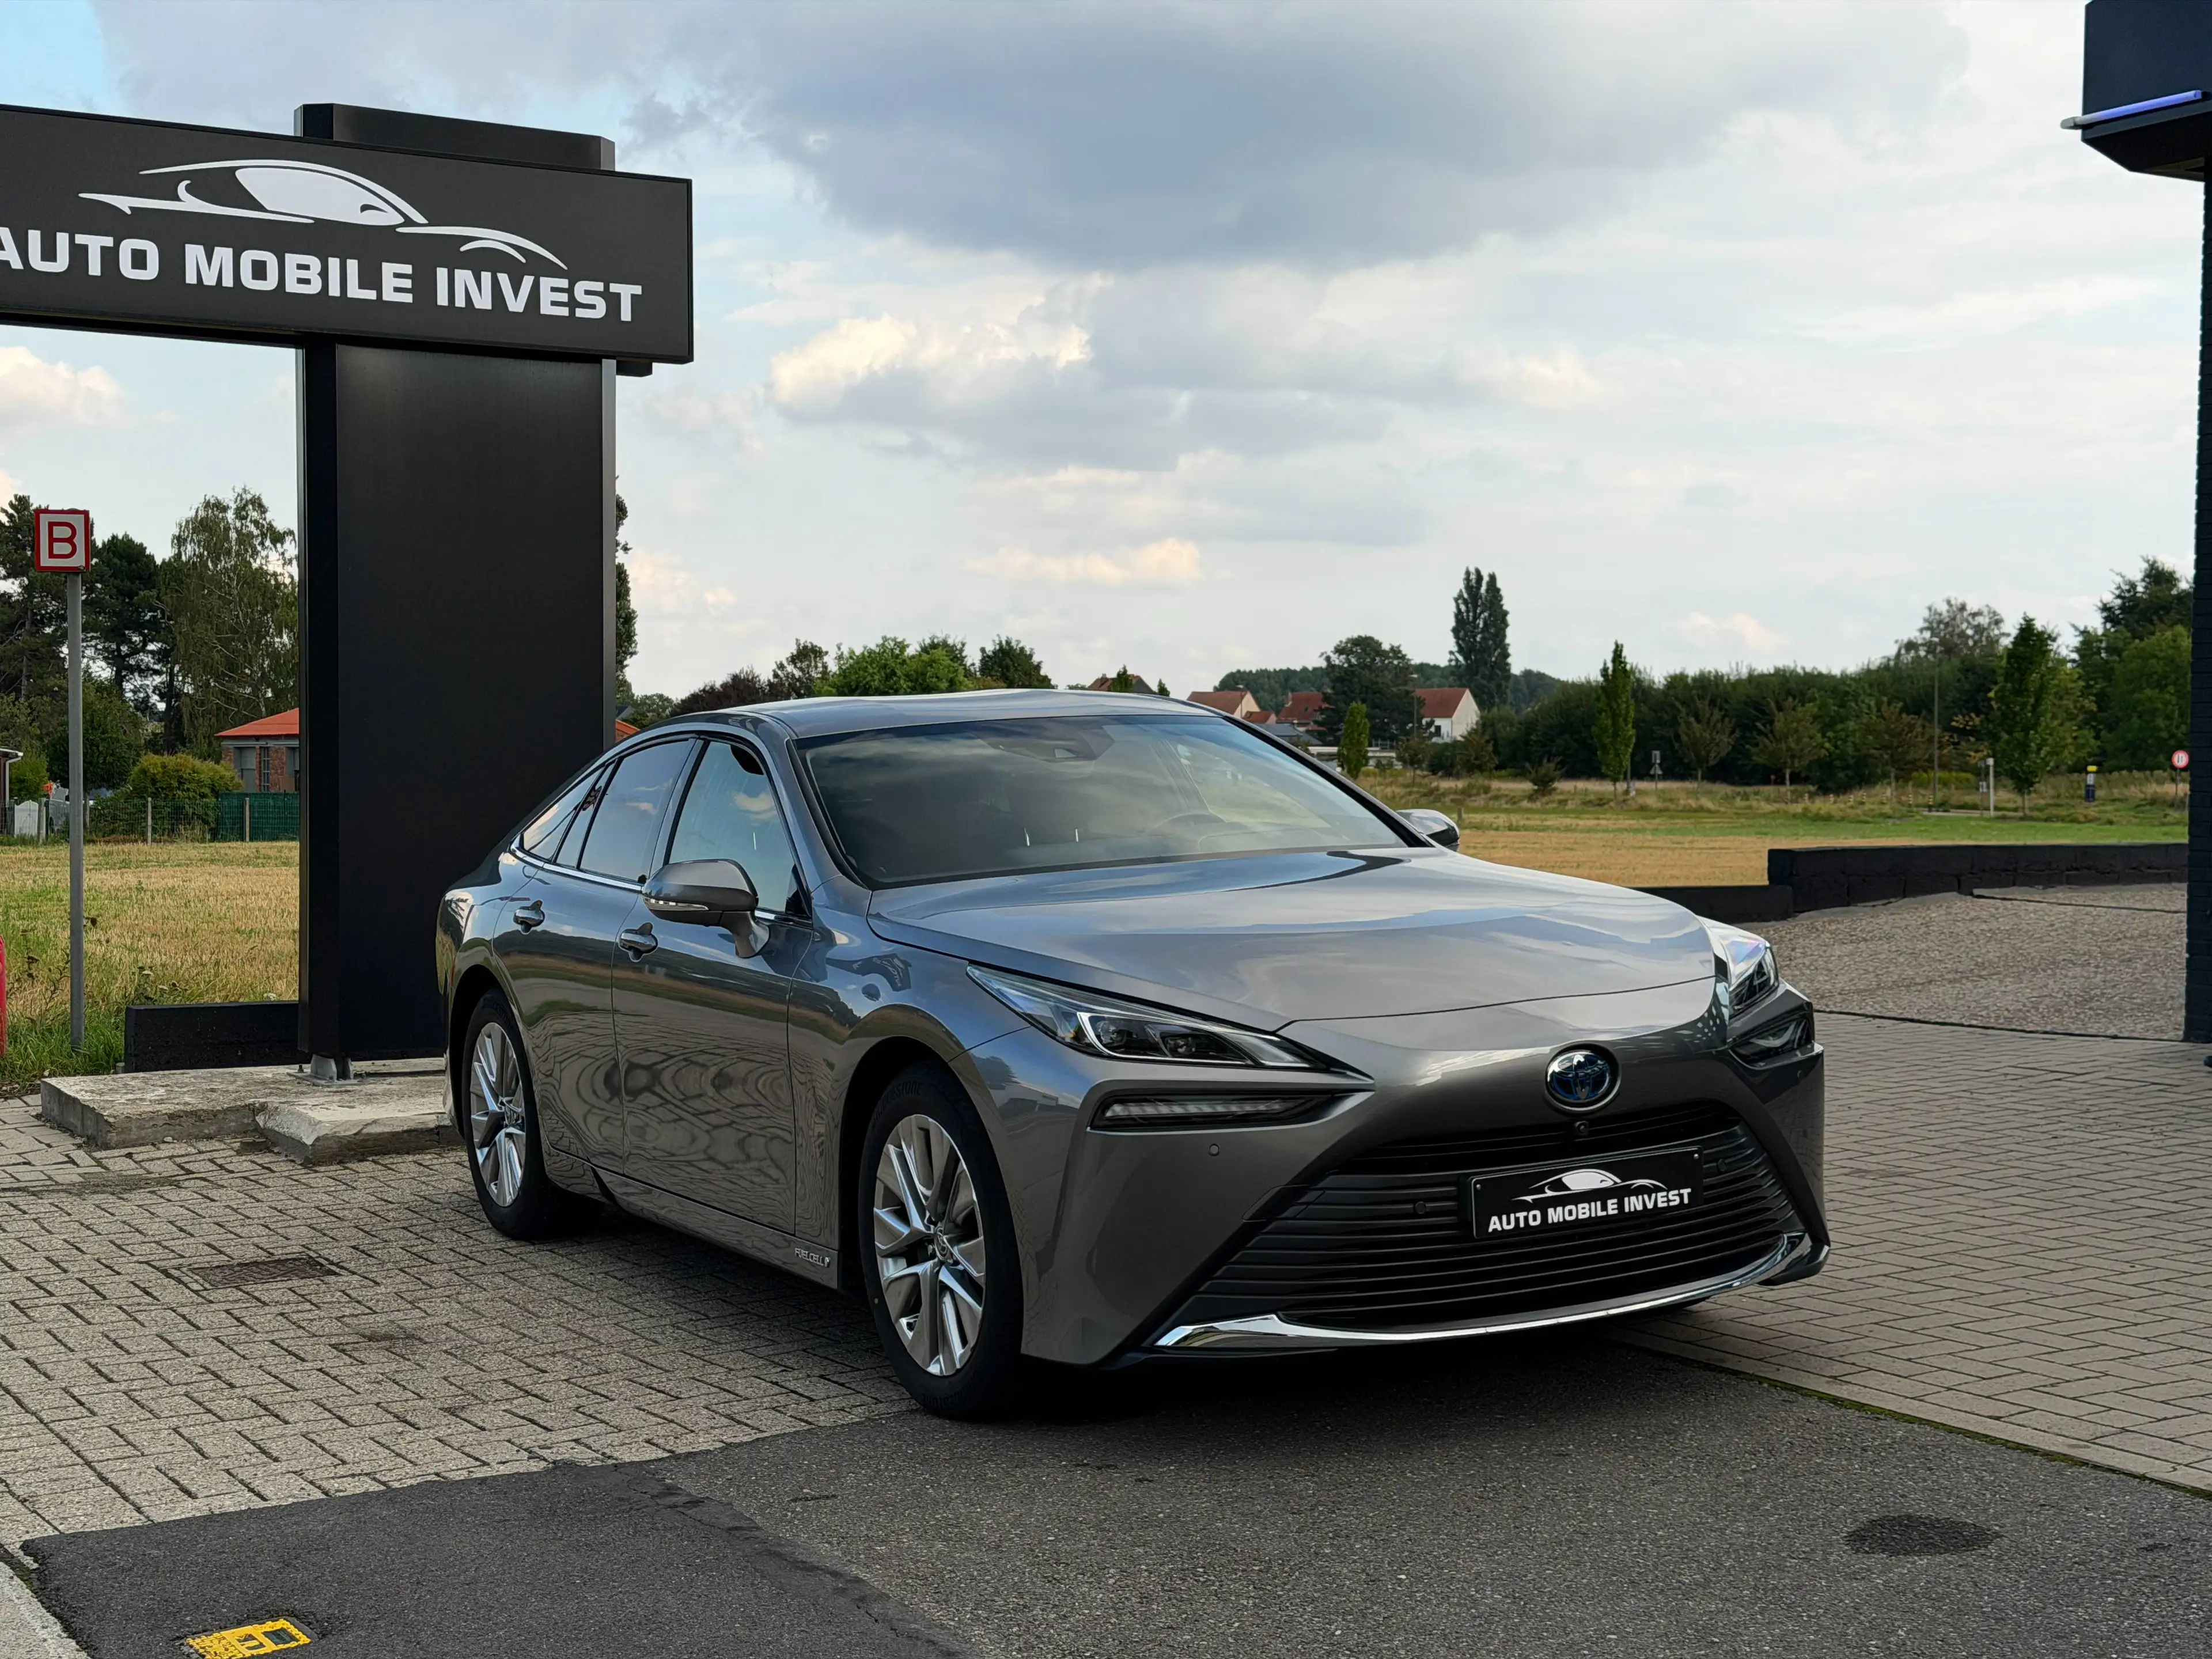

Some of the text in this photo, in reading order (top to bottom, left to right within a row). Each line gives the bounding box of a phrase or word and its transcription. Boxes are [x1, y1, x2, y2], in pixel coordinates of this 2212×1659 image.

[185, 244, 414, 304] MOBILE
[436, 266, 643, 322] INVEST
[47, 521, 77, 559] B
[1487, 1187, 1692, 1233] AUTO MOBILE INVEST
